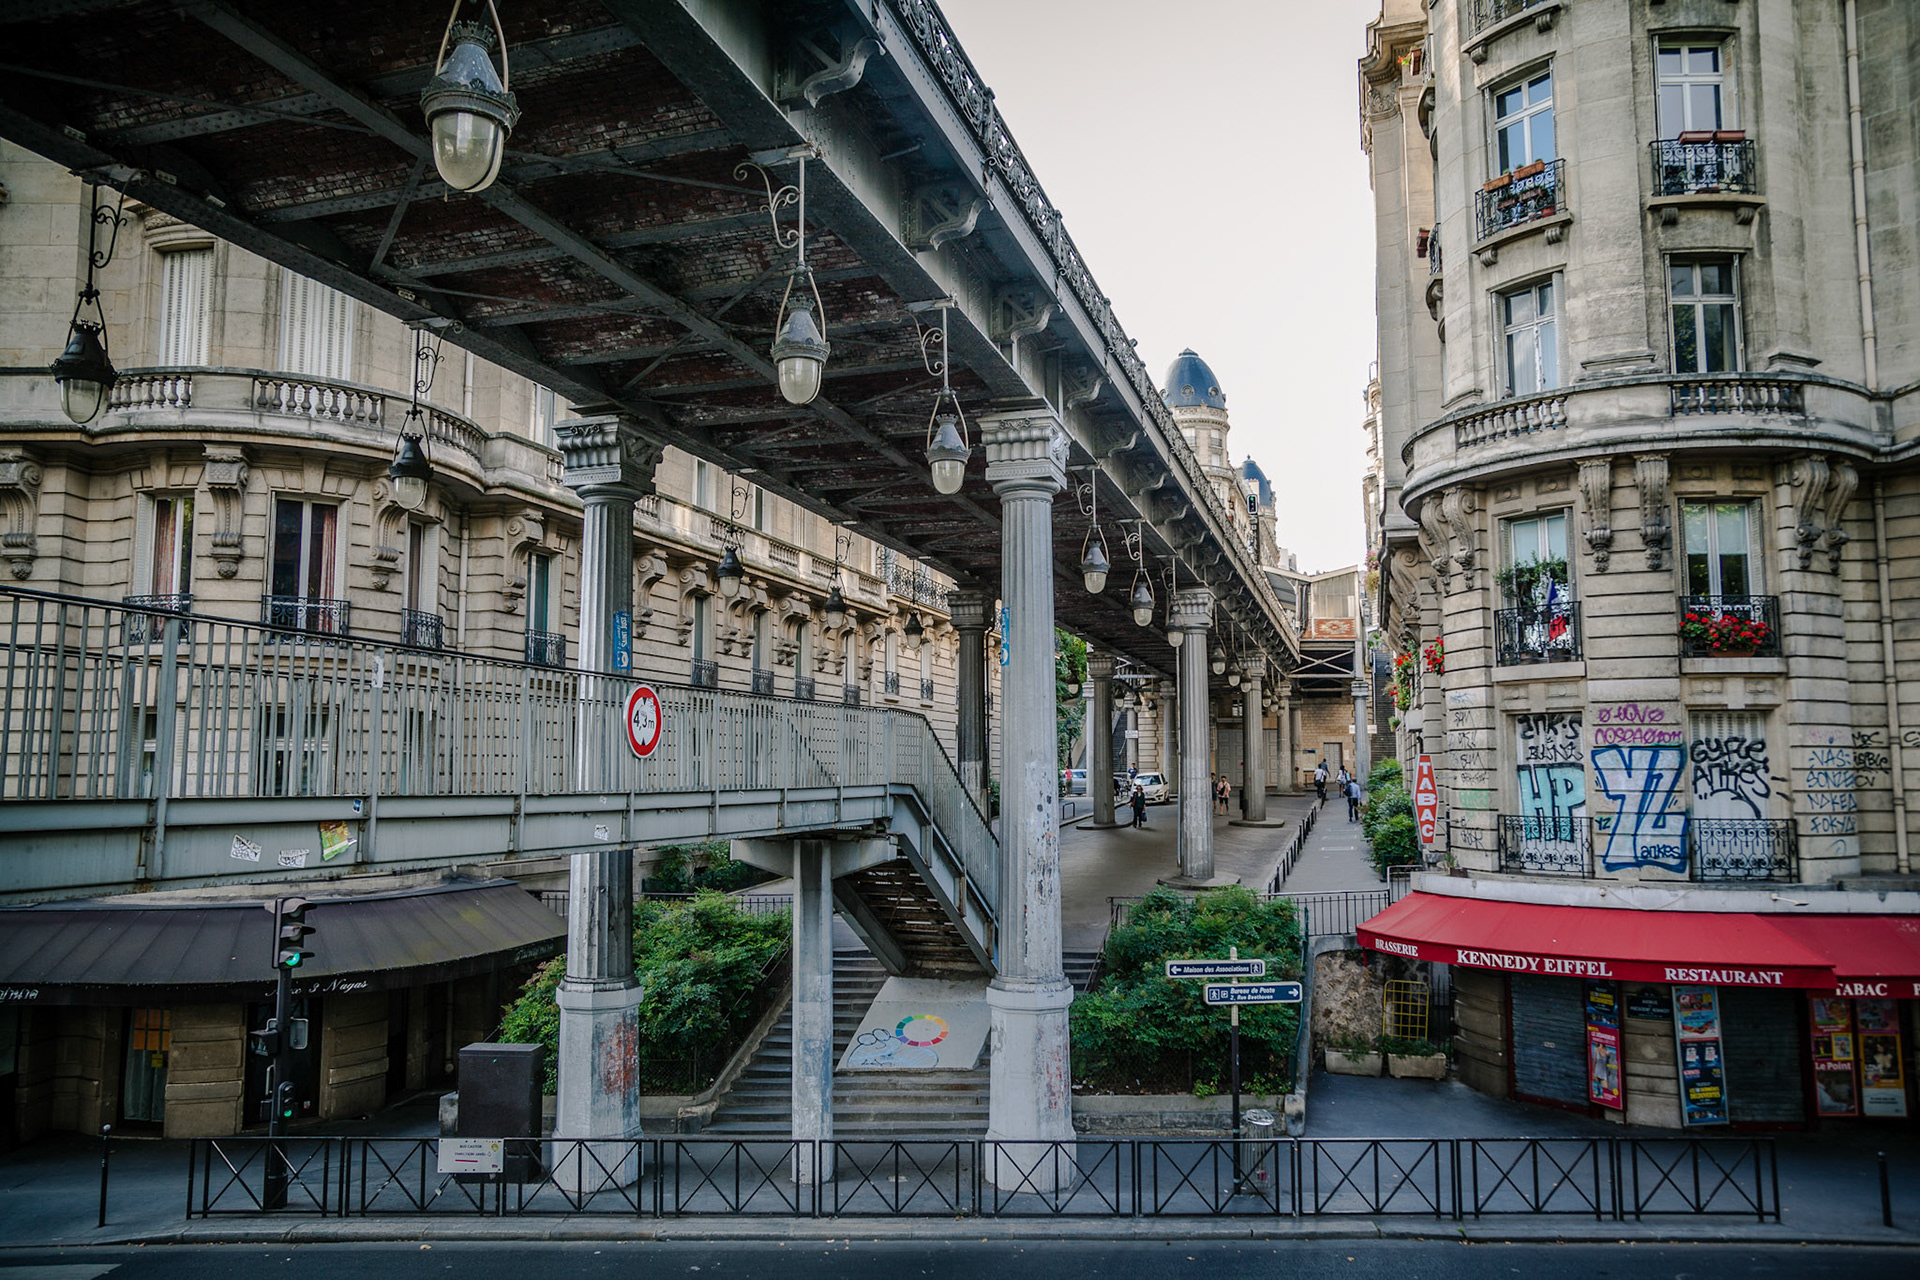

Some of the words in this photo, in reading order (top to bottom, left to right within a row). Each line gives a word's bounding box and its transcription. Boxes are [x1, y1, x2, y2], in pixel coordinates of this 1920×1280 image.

[1417, 762, 1437, 837] TABAC
[1375, 938, 1419, 957] BRASSERIE
[1183, 965, 1204, 973] Maison
[1215, 964, 1250, 972] Associations
[1456, 949, 1540, 971] KENNEDY
[1543, 958, 1613, 977] EIFFEL
[1664, 967, 1784, 985] RESTAURANT
[323, 978, 369, 994] Nagas
[1230, 986, 1250, 994] Bureau
[1250, 986, 1259, 994] de
[1835, 982, 1888, 996] TABAC
[1815, 1062, 1826, 1071] Le
[1827, 1061, 1852, 1071] Point
